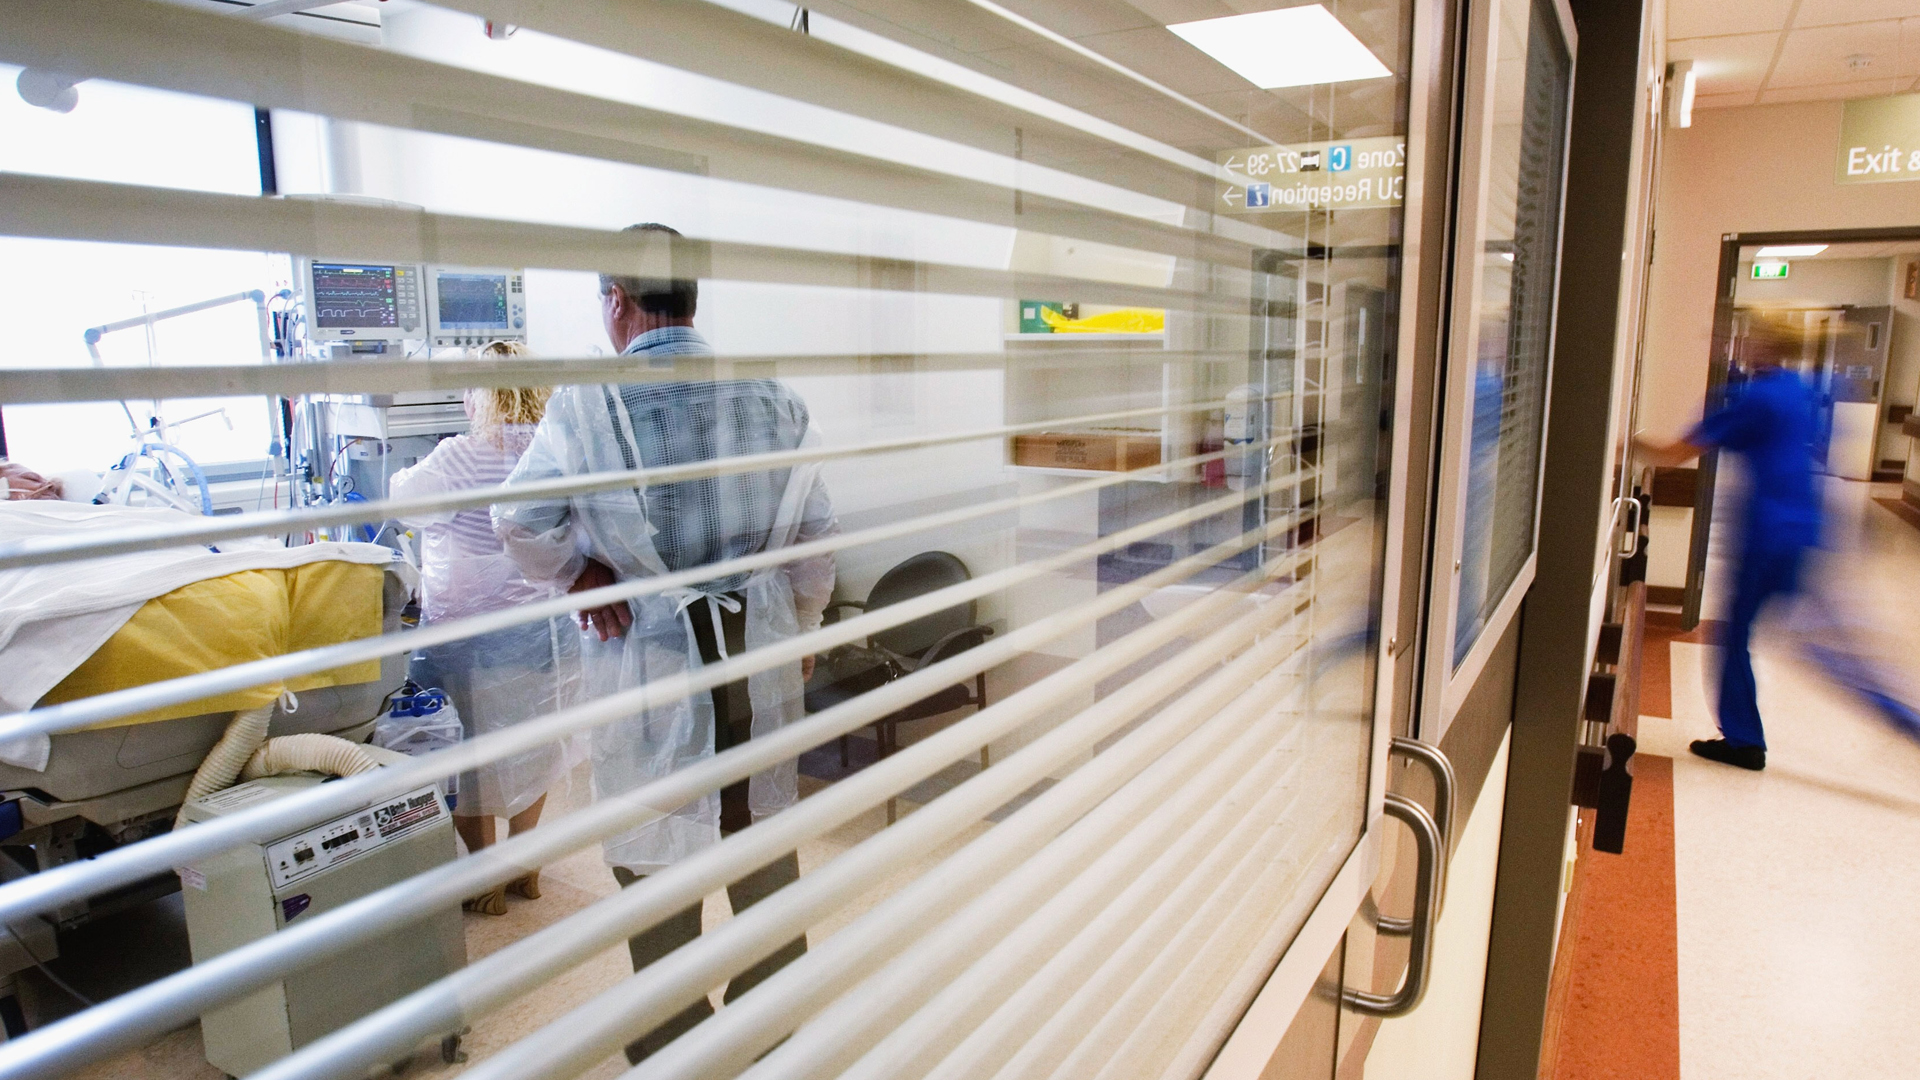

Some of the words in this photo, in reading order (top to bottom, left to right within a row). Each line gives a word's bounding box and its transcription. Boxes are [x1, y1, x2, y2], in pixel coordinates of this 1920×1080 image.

[1847, 144, 1903, 175] Exit
[1907, 149, 1920, 172] &
[407, 790, 435, 809] Hugger
